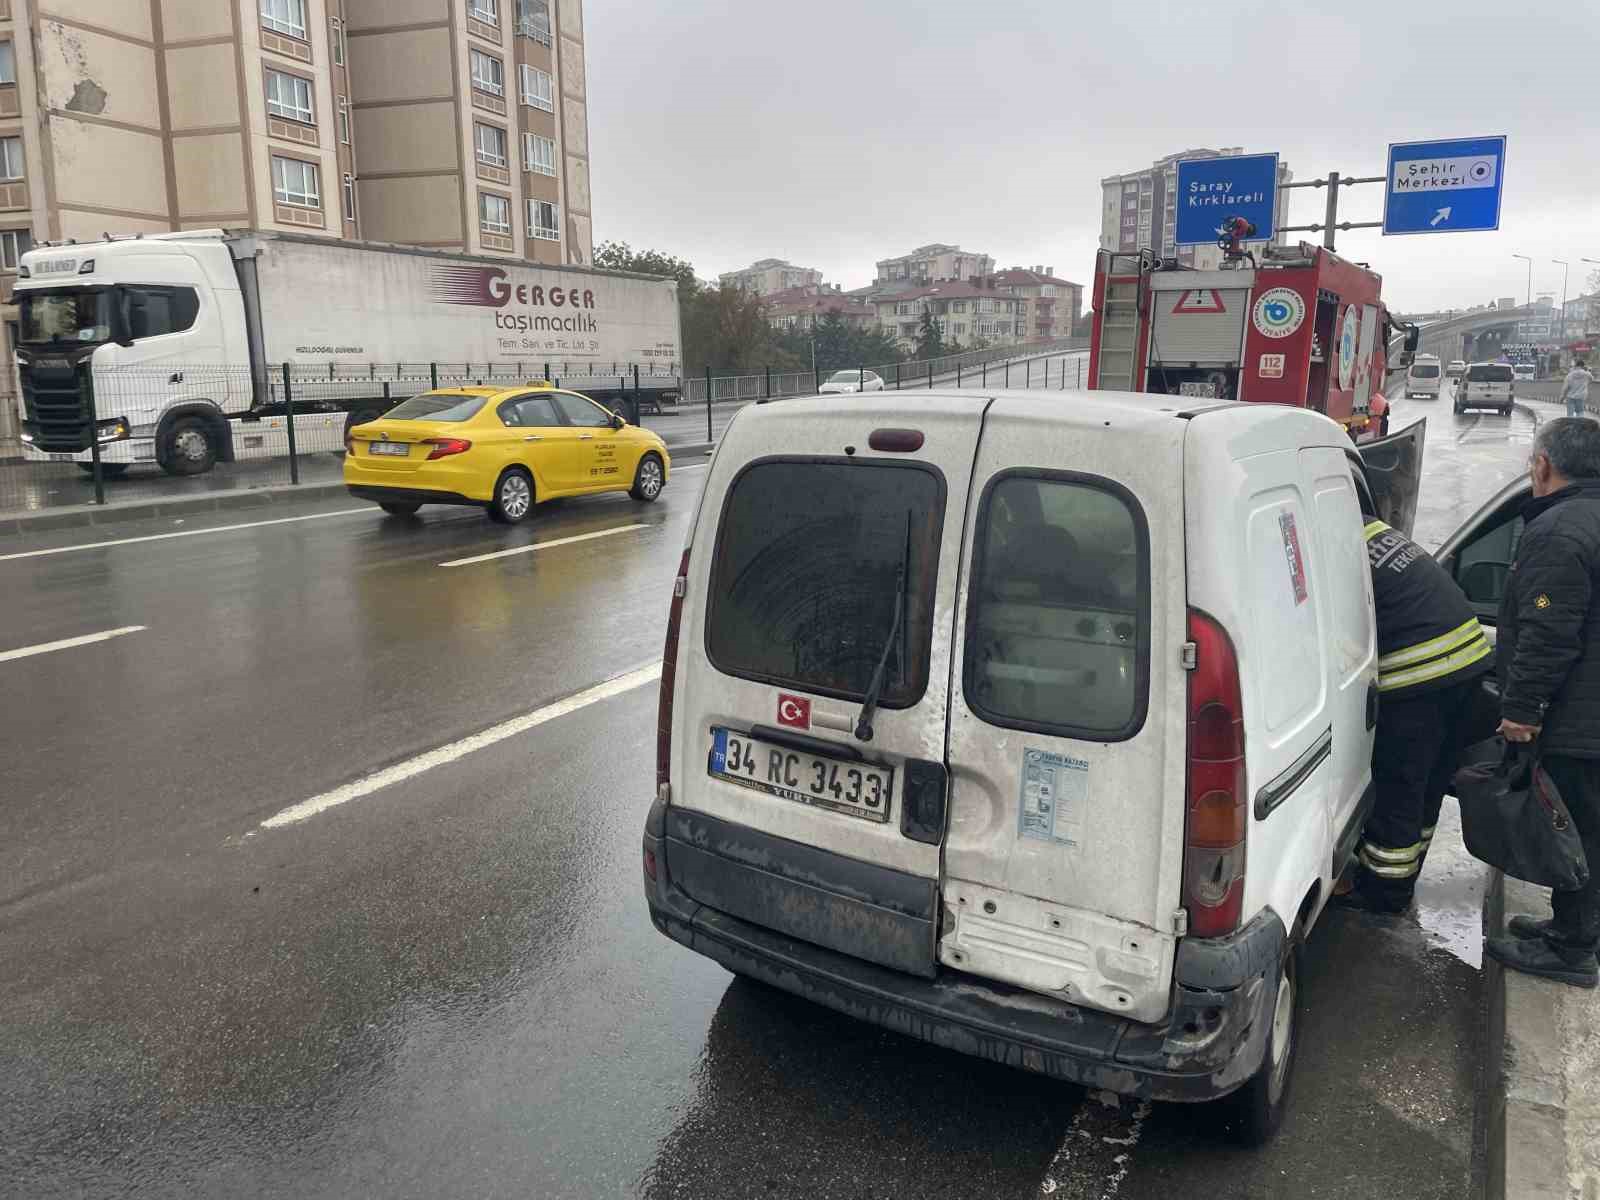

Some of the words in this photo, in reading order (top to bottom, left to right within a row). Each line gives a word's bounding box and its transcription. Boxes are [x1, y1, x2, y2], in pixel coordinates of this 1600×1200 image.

[1408, 163, 1455, 176] Şehir
[1189, 181, 1233, 193] Saray
[1397, 176, 1465, 189] Merkezi
[1189, 192, 1264, 208] Kırklareli
[495, 311, 598, 333] taşımacılık
[1263, 357, 1281, 368] 112
[714, 751, 725, 763] TR
[727, 739, 756, 776] 34
[767, 750, 800, 788] RC
[810, 761, 882, 808] 3433
